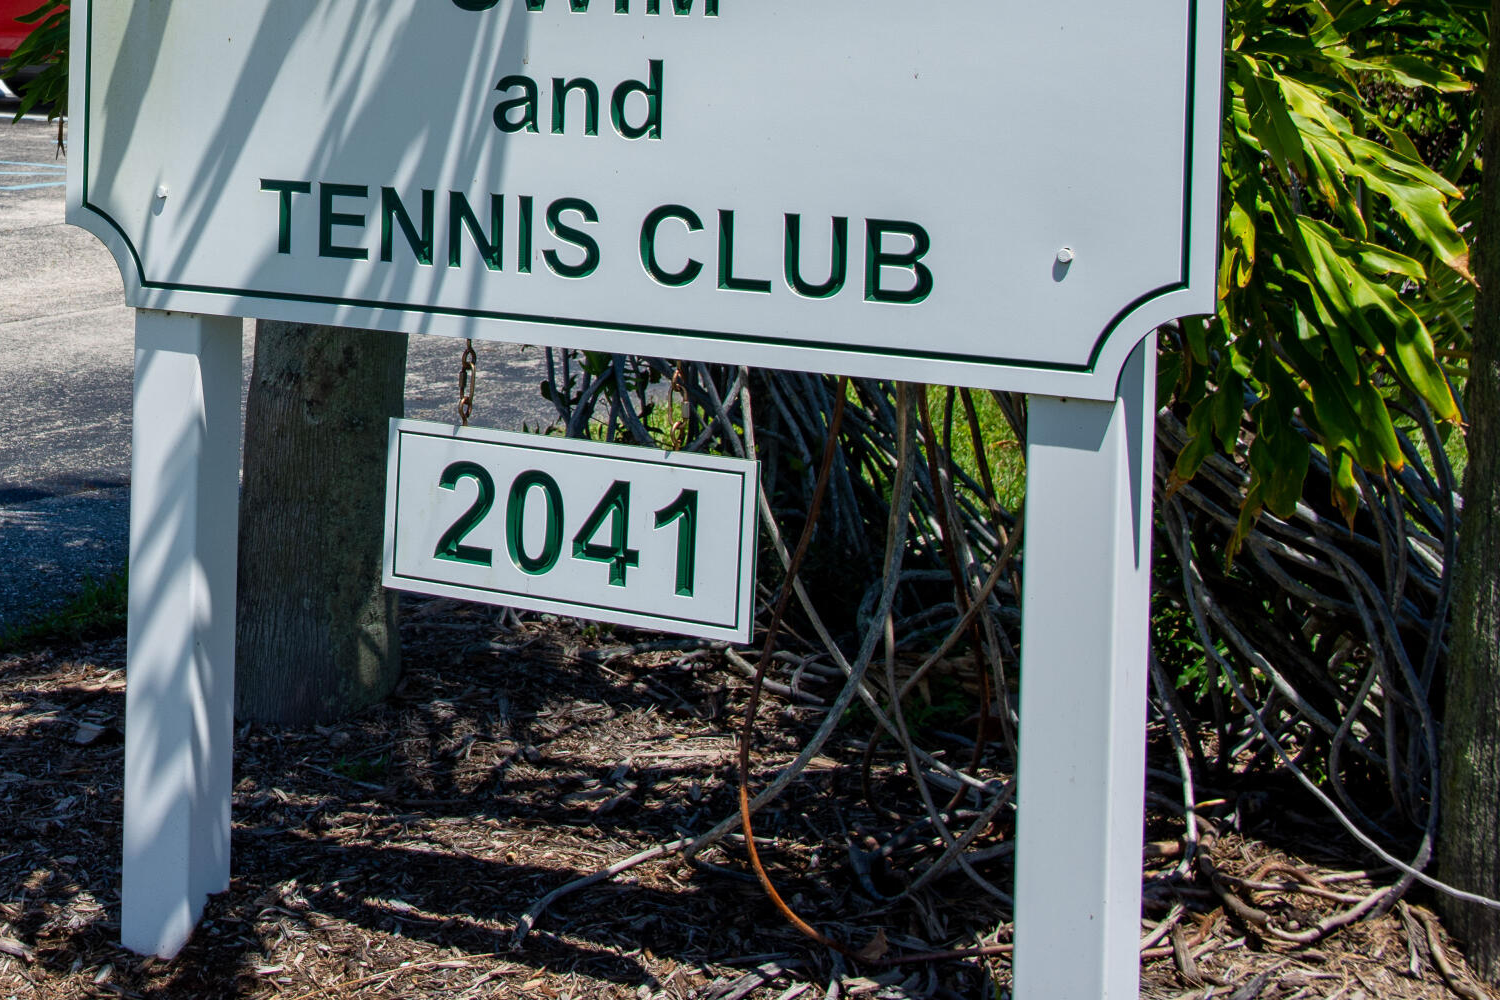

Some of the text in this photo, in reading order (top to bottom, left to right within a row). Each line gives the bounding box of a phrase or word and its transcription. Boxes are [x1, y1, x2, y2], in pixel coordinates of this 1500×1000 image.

[492, 59, 664, 140] and
[259, 178, 934, 304] TENNIS CLUB
[433, 460, 699, 598] 2041
